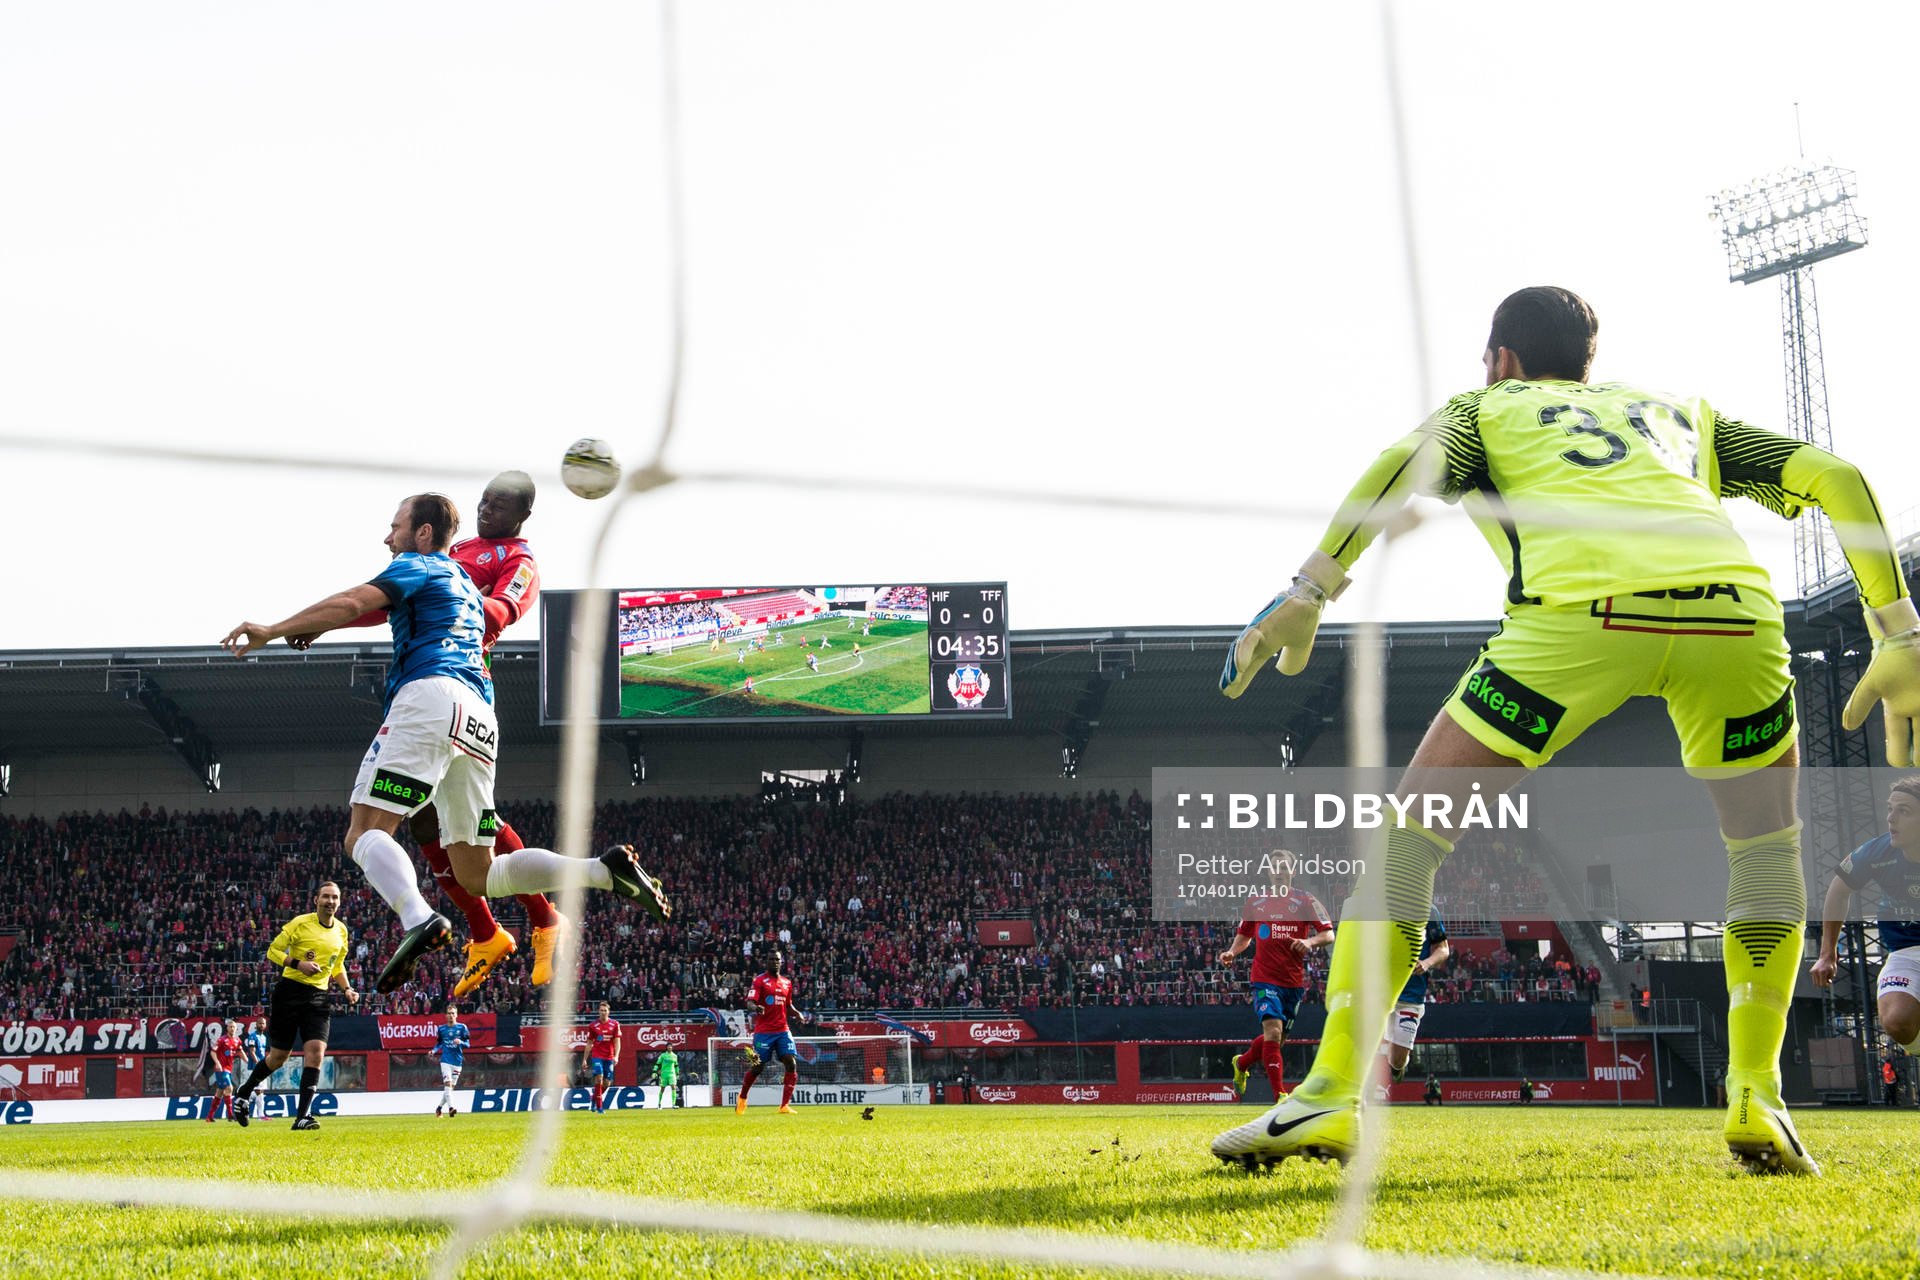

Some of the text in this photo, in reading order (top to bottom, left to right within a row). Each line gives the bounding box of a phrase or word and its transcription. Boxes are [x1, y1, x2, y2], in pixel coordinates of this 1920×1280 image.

[931, 590, 1002, 602] HIF TFF
[940, 608, 951, 624] 0
[983, 607, 994, 624] 0
[937, 635, 999, 656] 04:35
[1468, 672, 1519, 722] akea
[465, 715, 496, 750] BCA
[1726, 715, 1784, 749] akea
[373, 777, 412, 799] akea
[0, 1021, 84, 1054] ÖDRA
[94, 1019, 148, 1050] STÅ
[637, 1026, 686, 1048] Carlsberg
[969, 1023, 1021, 1044] Carlsberg
[1593, 1066, 1637, 1081] PUMA
[814, 1094, 837, 1104] om
[840, 1090, 867, 1105] HIF
[979, 1086, 1016, 1102] Carlsberg
